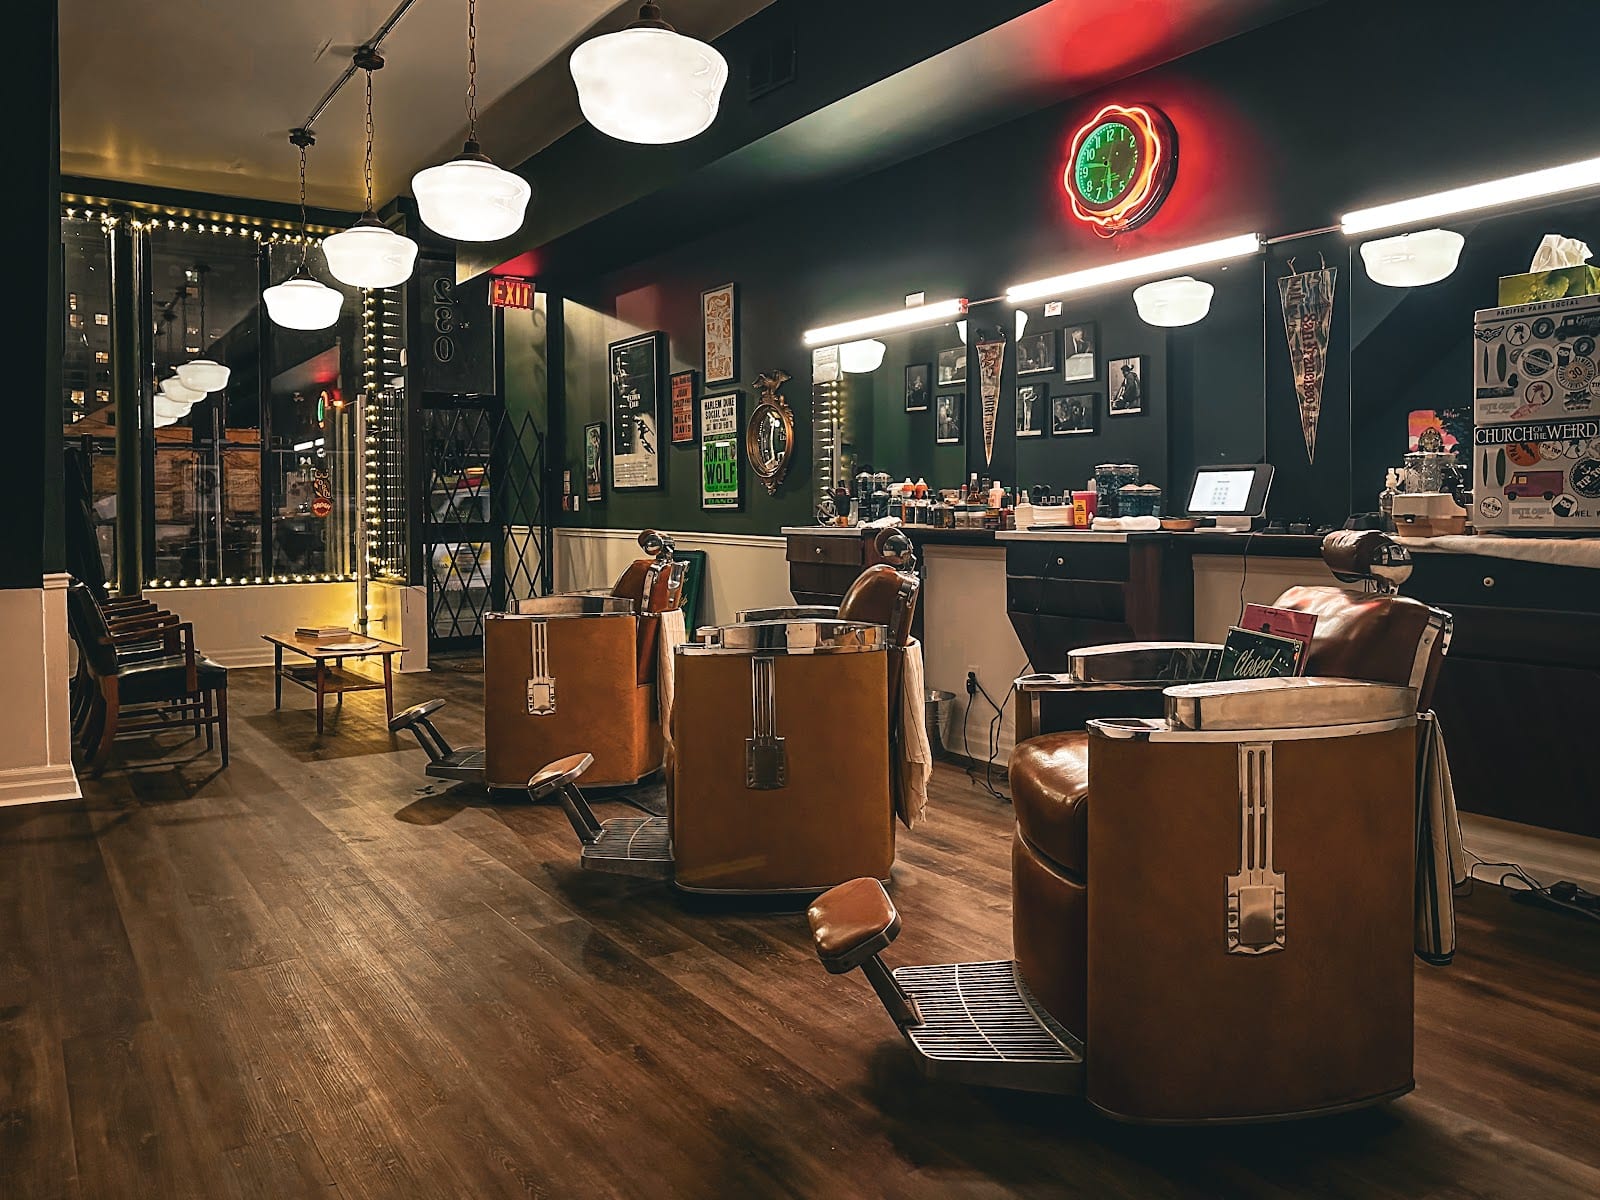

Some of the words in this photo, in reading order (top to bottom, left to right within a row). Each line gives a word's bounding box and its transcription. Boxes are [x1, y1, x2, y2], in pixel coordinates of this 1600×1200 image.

[1106, 129, 1115, 142] 12
[1120, 129, 1125, 141] 1
[1095, 137, 1101, 149] 11
[1129, 136, 1136, 148] 2
[1086, 148, 1096, 161] 10
[1082, 166, 1089, 178] 9
[1086, 181, 1093, 192] 8
[1119, 181, 1126, 193] 5
[1096, 187, 1102, 200] 7
[1106, 188, 1114, 200] 6
[494, 280, 531, 305] EXIT
[1496, 307, 1525, 316] PACIFIC
[1528, 304, 1548, 312] PARK
[1551, 300, 1580, 309] SOCIAL
[1569, 366, 1583, 379] 30
[704, 400, 722, 410] HARLEM
[723, 397, 735, 407] DUKE
[984, 394, 995, 417] PORT
[705, 409, 721, 420] SOCIAL
[722, 407, 734, 417] CLUB
[1475, 426, 1533, 444] CHURCH
[1533, 432, 1547, 440] THE
[1546, 422, 1598, 440] WEIRD
[705, 462, 736, 485] WOLF
[1576, 475, 1592, 489] TIP
[1233, 648, 1281, 678] Closed
